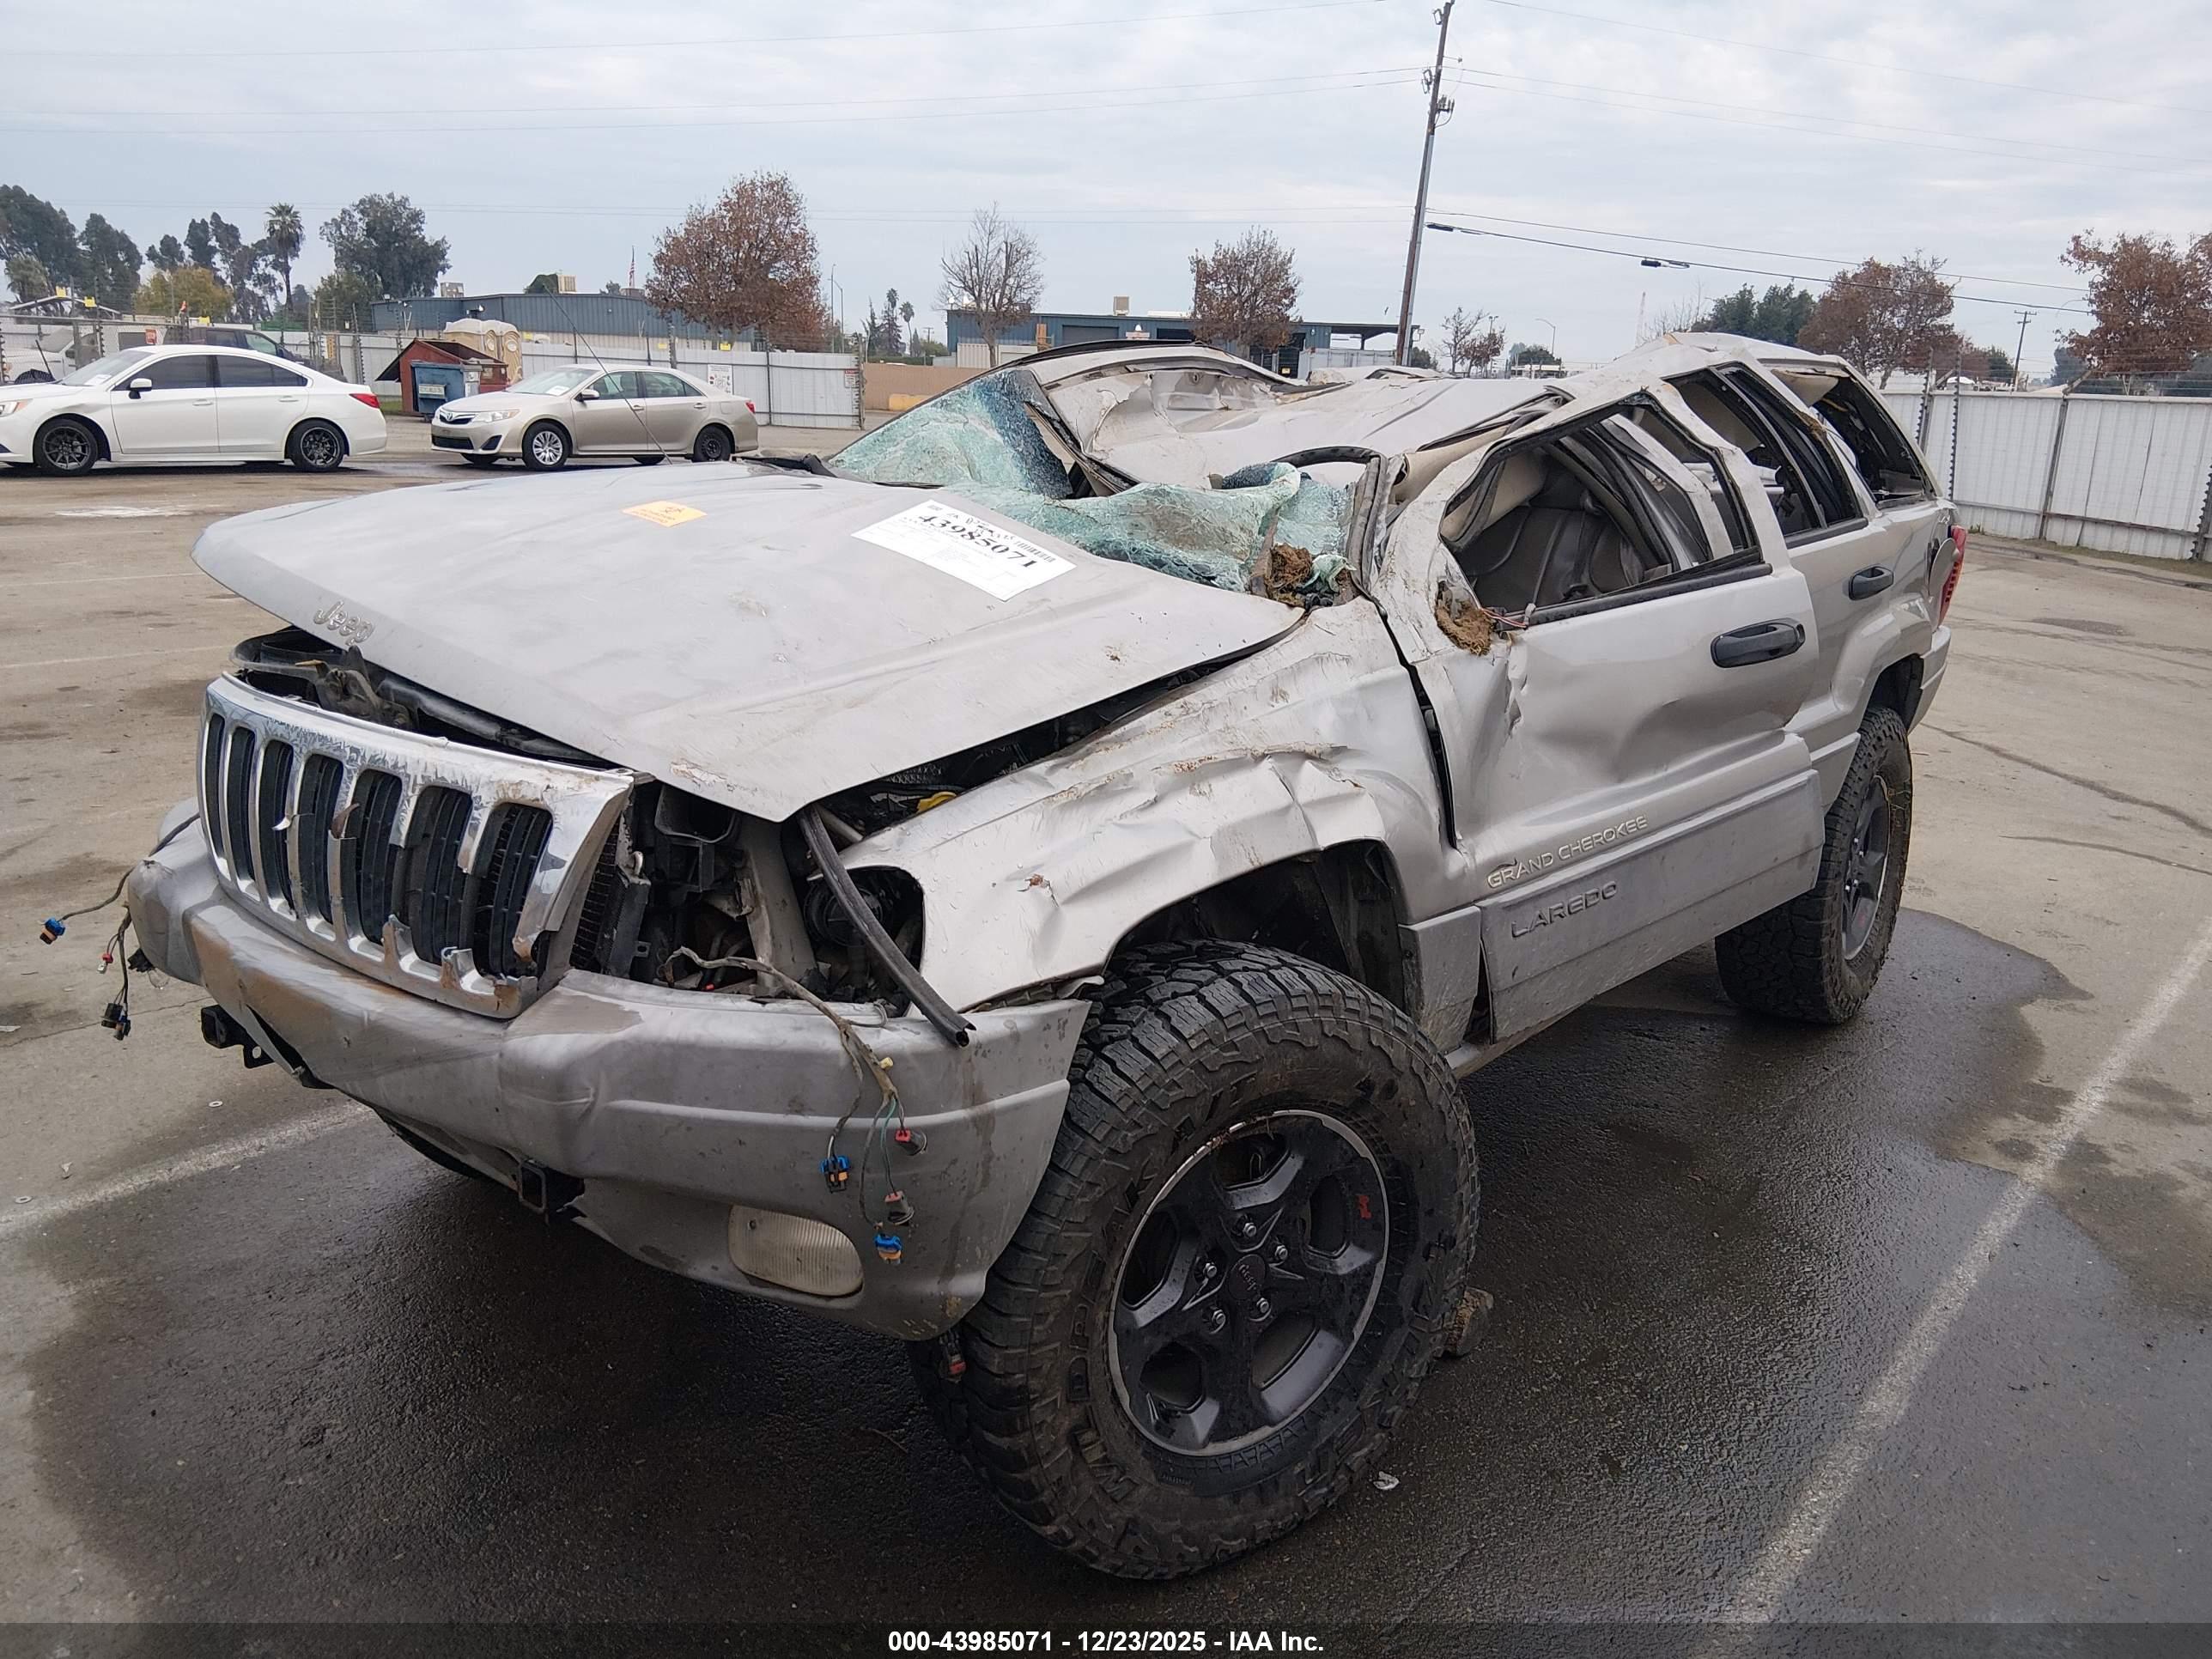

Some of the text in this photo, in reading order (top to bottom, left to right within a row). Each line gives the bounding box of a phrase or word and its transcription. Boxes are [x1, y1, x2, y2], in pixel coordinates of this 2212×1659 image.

[918, 515, 1037, 568] 43985071
[313, 600, 374, 646] Jeep
[1487, 816, 1648, 889] GRAND CHEROKEE
[1511, 880, 1619, 939] LAREDO
